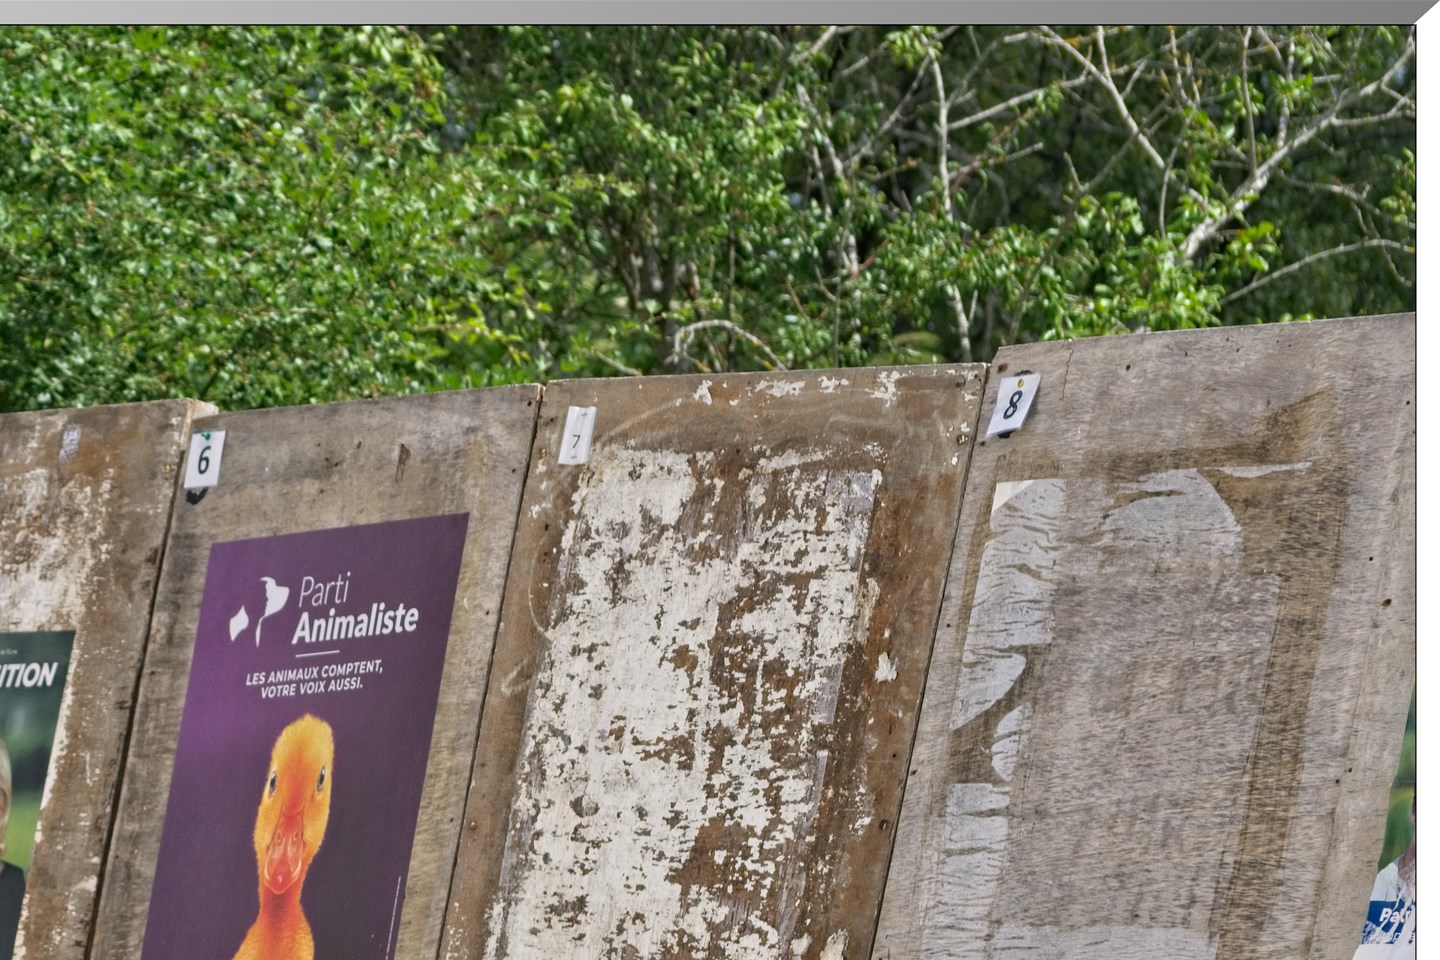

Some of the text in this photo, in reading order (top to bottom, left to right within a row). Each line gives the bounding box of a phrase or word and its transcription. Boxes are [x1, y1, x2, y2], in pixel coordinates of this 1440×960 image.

[1003, 390, 1023, 420] 8
[573, 434, 581, 449] 7
[198, 445, 212, 475] 6
[298, 571, 352, 608] Parti
[291, 602, 419, 645] Animaliste
[246, 659, 384, 686] LES ANIMAUX COMPTENT,
[261, 676, 364, 699] VOTRE VOIX AUSSI.
